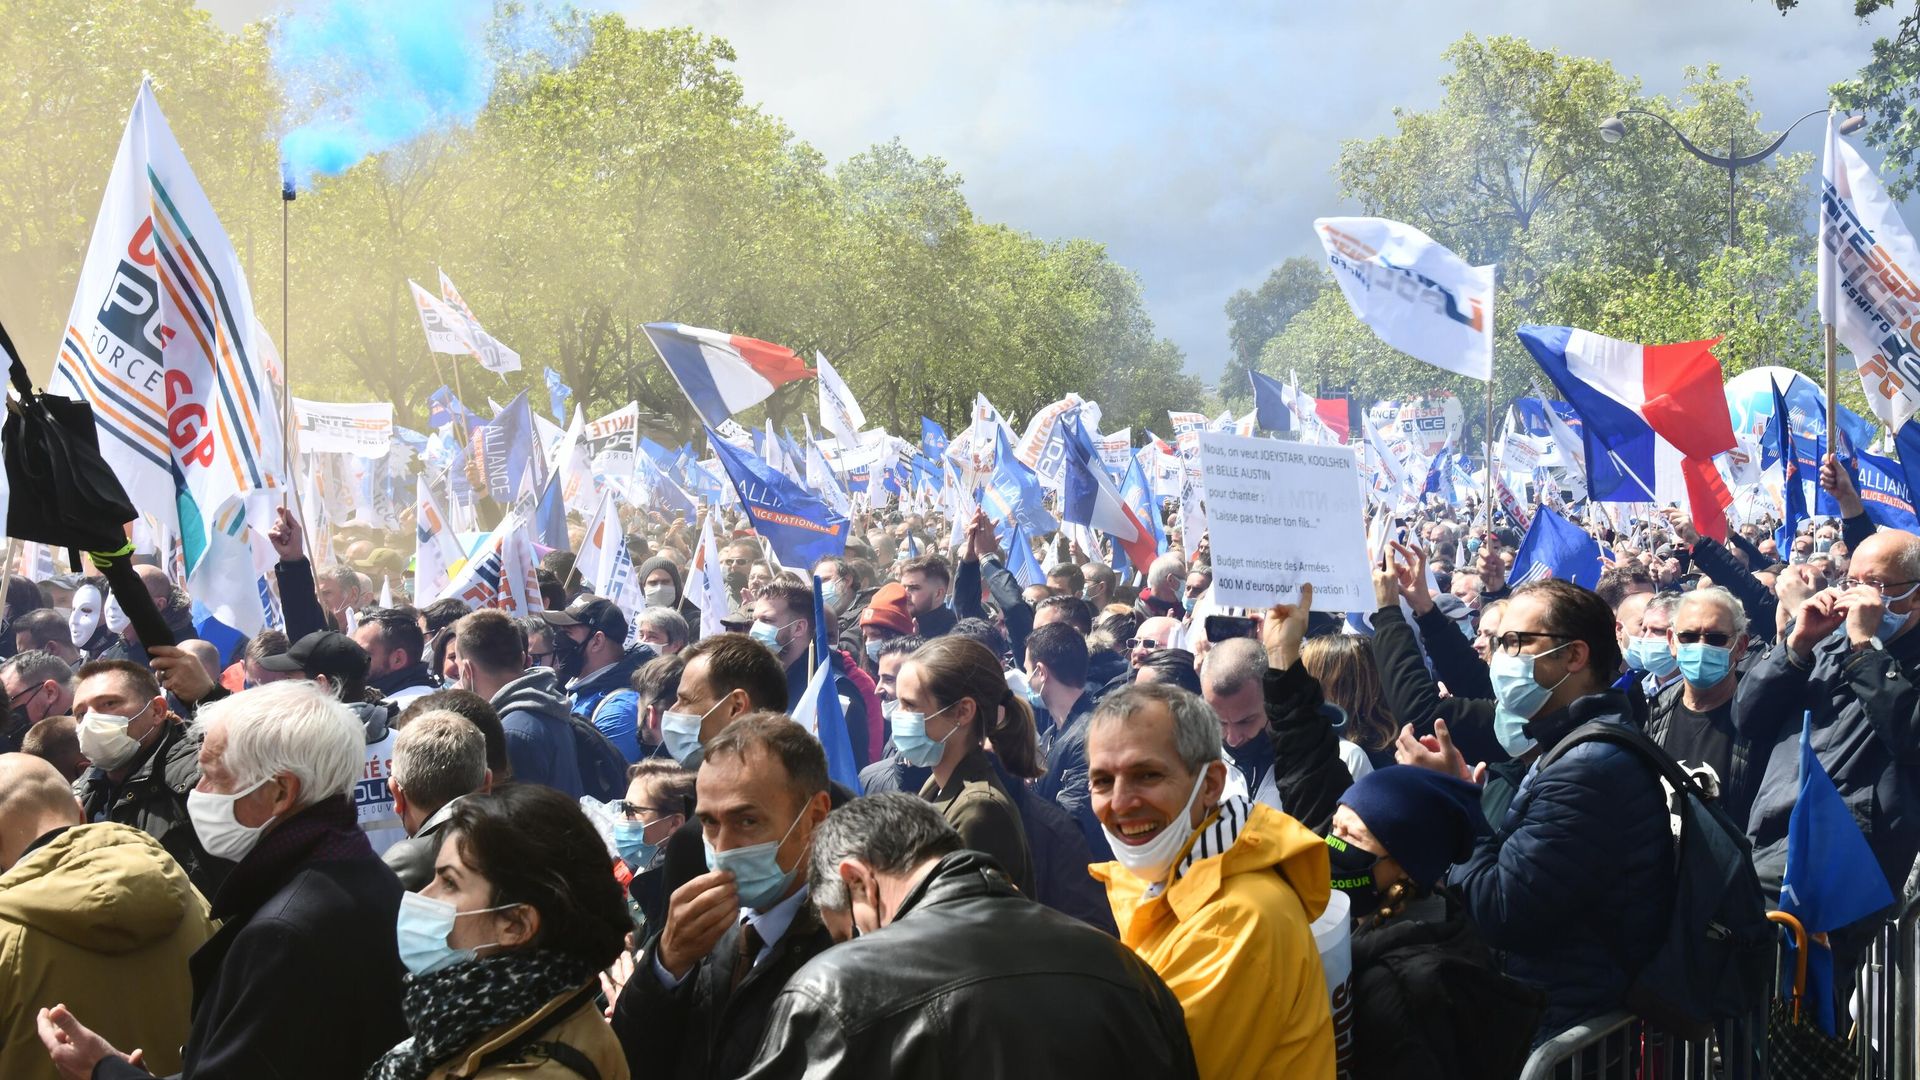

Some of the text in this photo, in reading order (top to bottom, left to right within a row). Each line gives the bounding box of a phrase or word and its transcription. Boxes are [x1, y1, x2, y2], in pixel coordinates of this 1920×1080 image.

[1841, 279, 1891, 333] FSMI-FO
[482, 425, 511, 497] ALLIANCE
[1203, 443, 1350, 468] Nous, on veut JOEYSTARR, KOOLSHEN
[1206, 465, 1214, 475] et
[1216, 464, 1239, 478] BELLE
[1241, 468, 1271, 481] AUSTIN
[1208, 488, 1227, 500] pour
[1228, 488, 1260, 502] chanter
[1240, 514, 1254, 525] pas
[1255, 513, 1282, 526] traîner
[1283, 517, 1297, 528] ton
[1216, 554, 1244, 570] Budget
[1245, 558, 1282, 571] ministère
[1284, 560, 1298, 572] des
[1299, 561, 1330, 573] Armées
[1218, 578, 1234, 590] 400
[1235, 579, 1244, 590] M
[1245, 579, 1274, 592] d'euros
[1275, 583, 1293, 596] pour
[1330, 876, 1370, 889] COEUR
